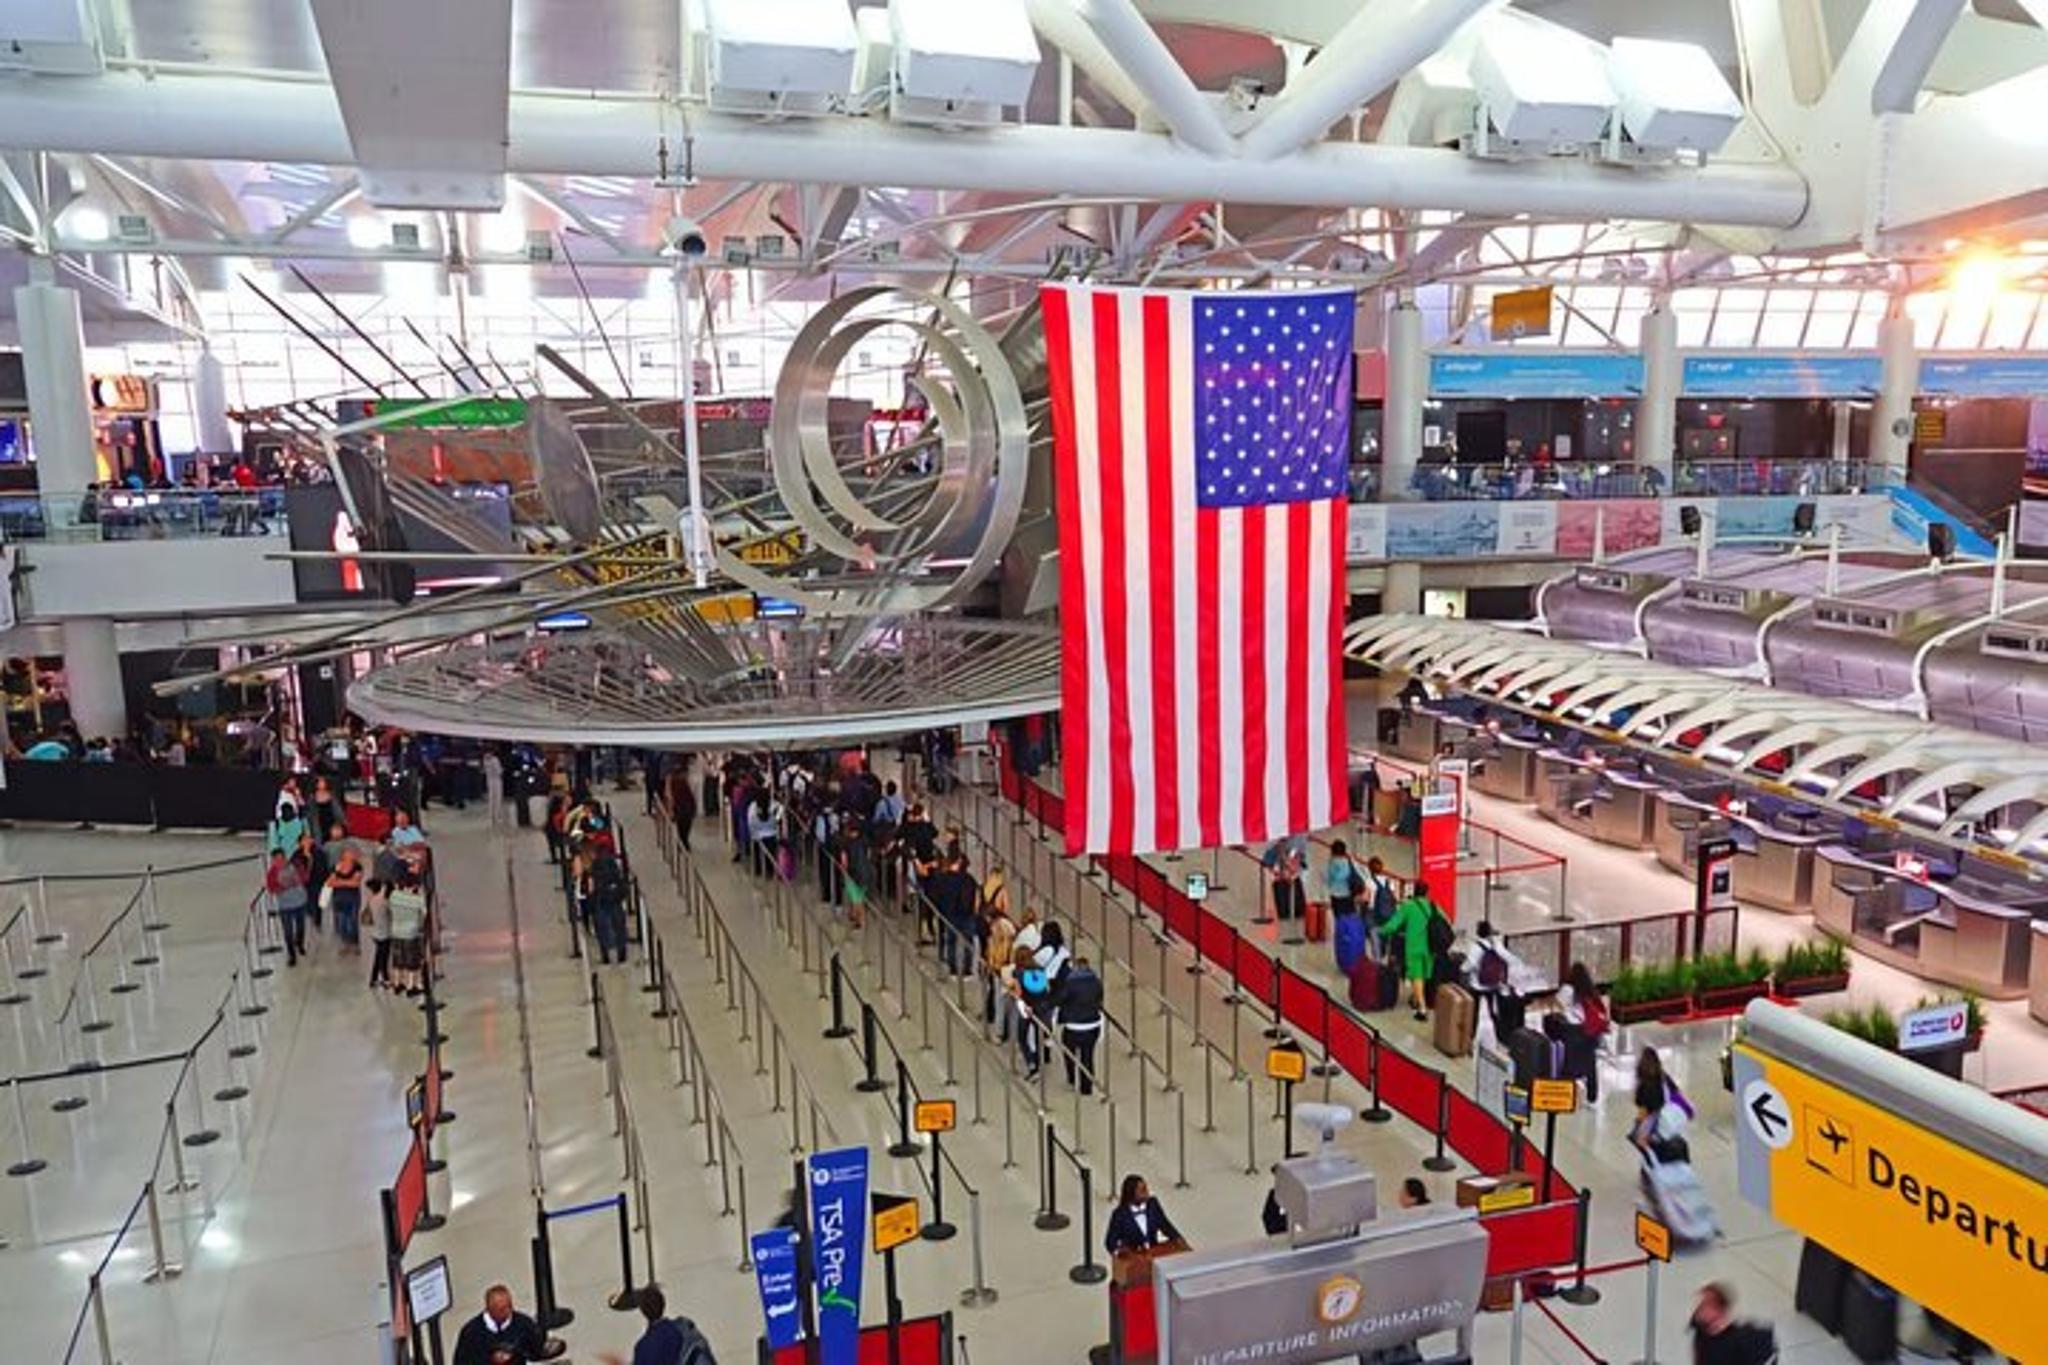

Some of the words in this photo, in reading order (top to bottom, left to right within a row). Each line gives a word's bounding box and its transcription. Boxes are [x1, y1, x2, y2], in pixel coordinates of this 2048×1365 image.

[819, 1197, 843, 1246] TSA
[1868, 1147, 2048, 1273] Departu
[1329, 1299, 1463, 1341] INFORMATION
